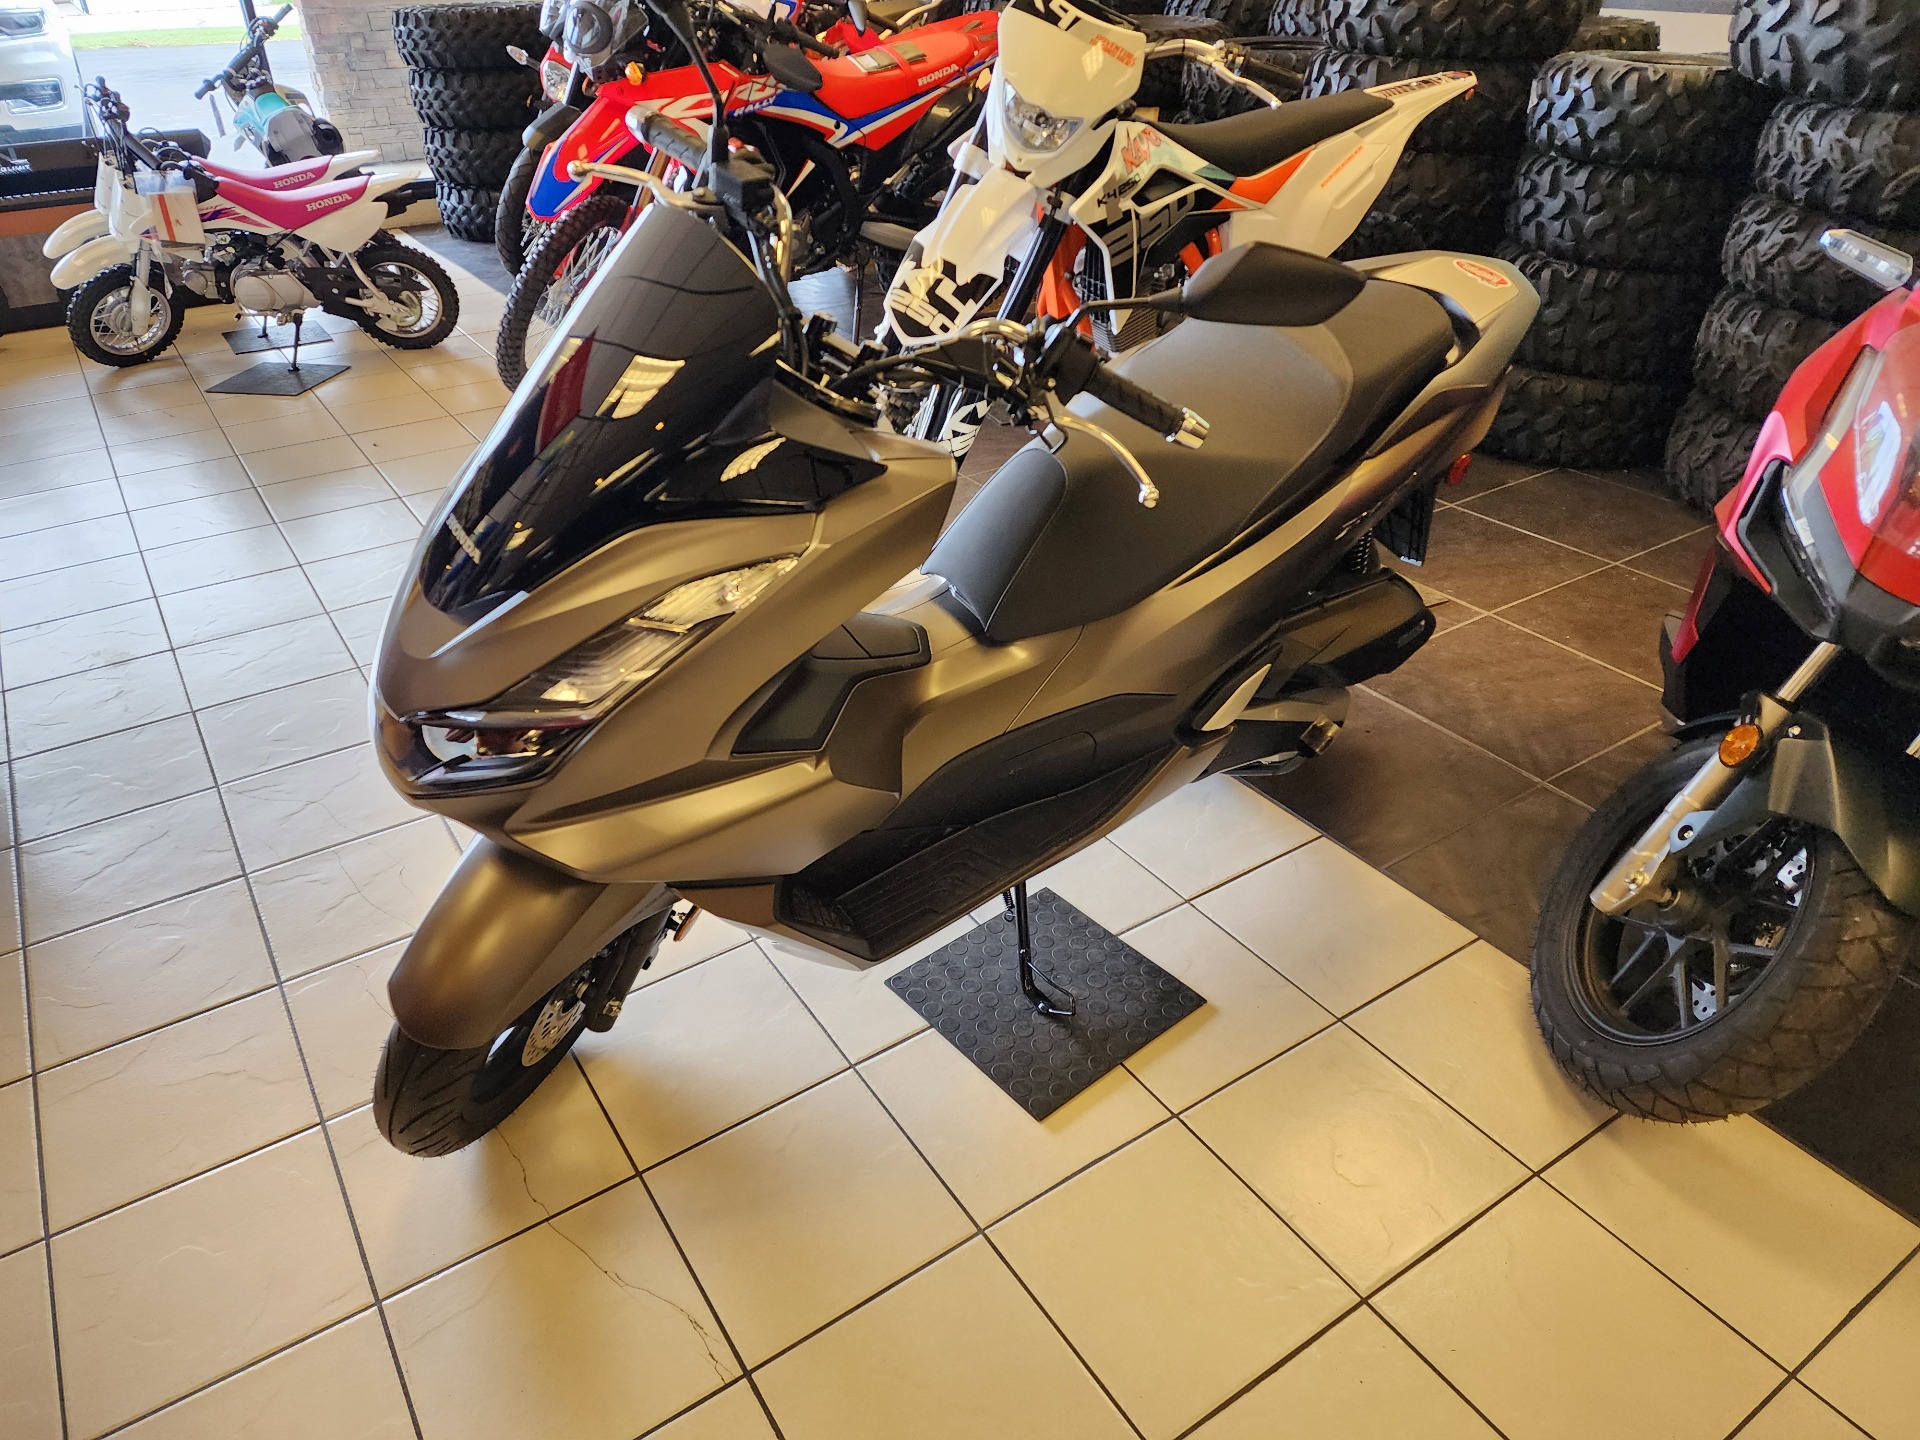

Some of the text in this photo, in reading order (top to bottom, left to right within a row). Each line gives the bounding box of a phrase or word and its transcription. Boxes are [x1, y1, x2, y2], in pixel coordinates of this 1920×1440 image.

[917, 63, 960, 86] HONDA
[733, 95, 777, 117] RALLY
[273, 171, 316, 189] HONDA
[305, 193, 352, 212] HONDA
[889, 287, 957, 335] 250
[445, 512, 481, 565] HONDA
